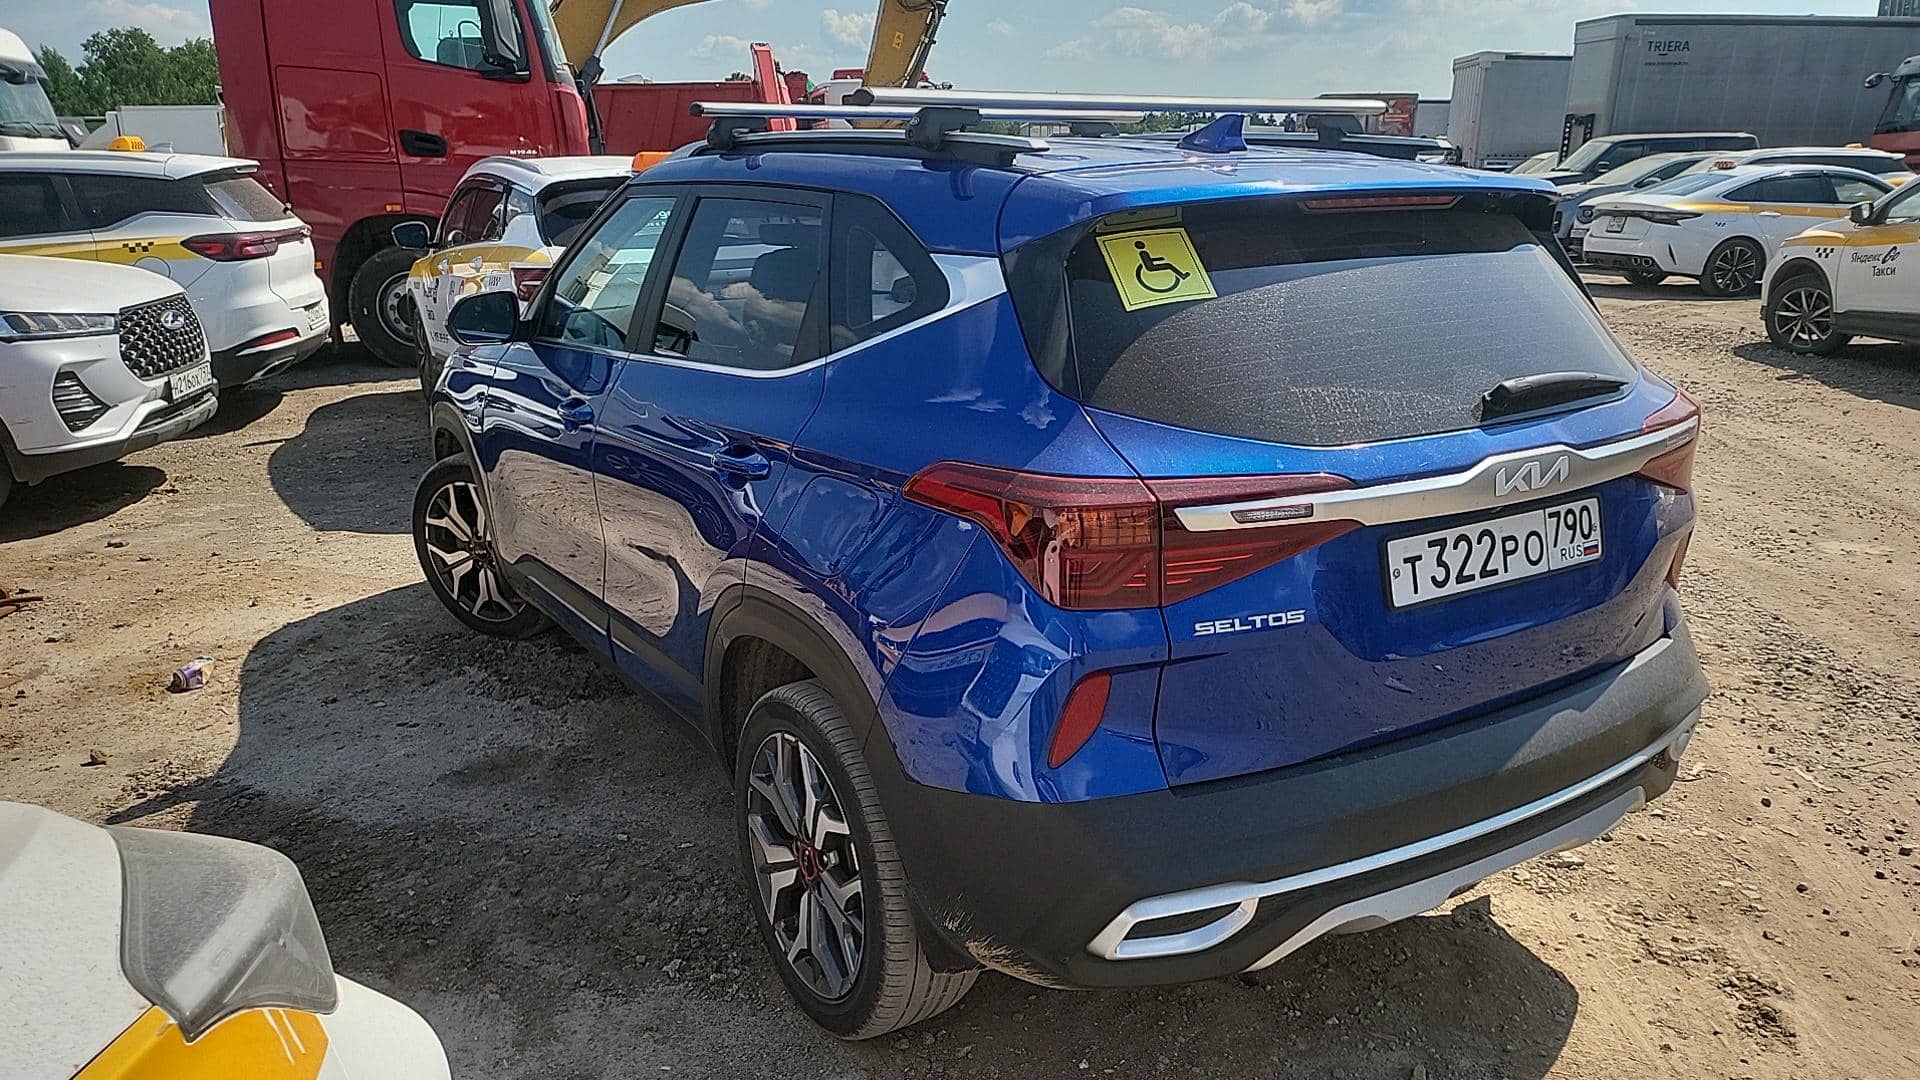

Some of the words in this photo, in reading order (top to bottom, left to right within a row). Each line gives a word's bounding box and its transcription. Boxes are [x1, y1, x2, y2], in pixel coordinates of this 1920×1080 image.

[1647, 40, 1690, 52] TRIERA
[1850, 252, 1884, 264] Яндекс
[1871, 265, 1896, 277] Такси
[1496, 456, 1569, 496] KIA
[1548, 505, 1593, 548] 790
[1560, 546, 1583, 562] RUS
[1193, 609, 1306, 637] SELTOS
